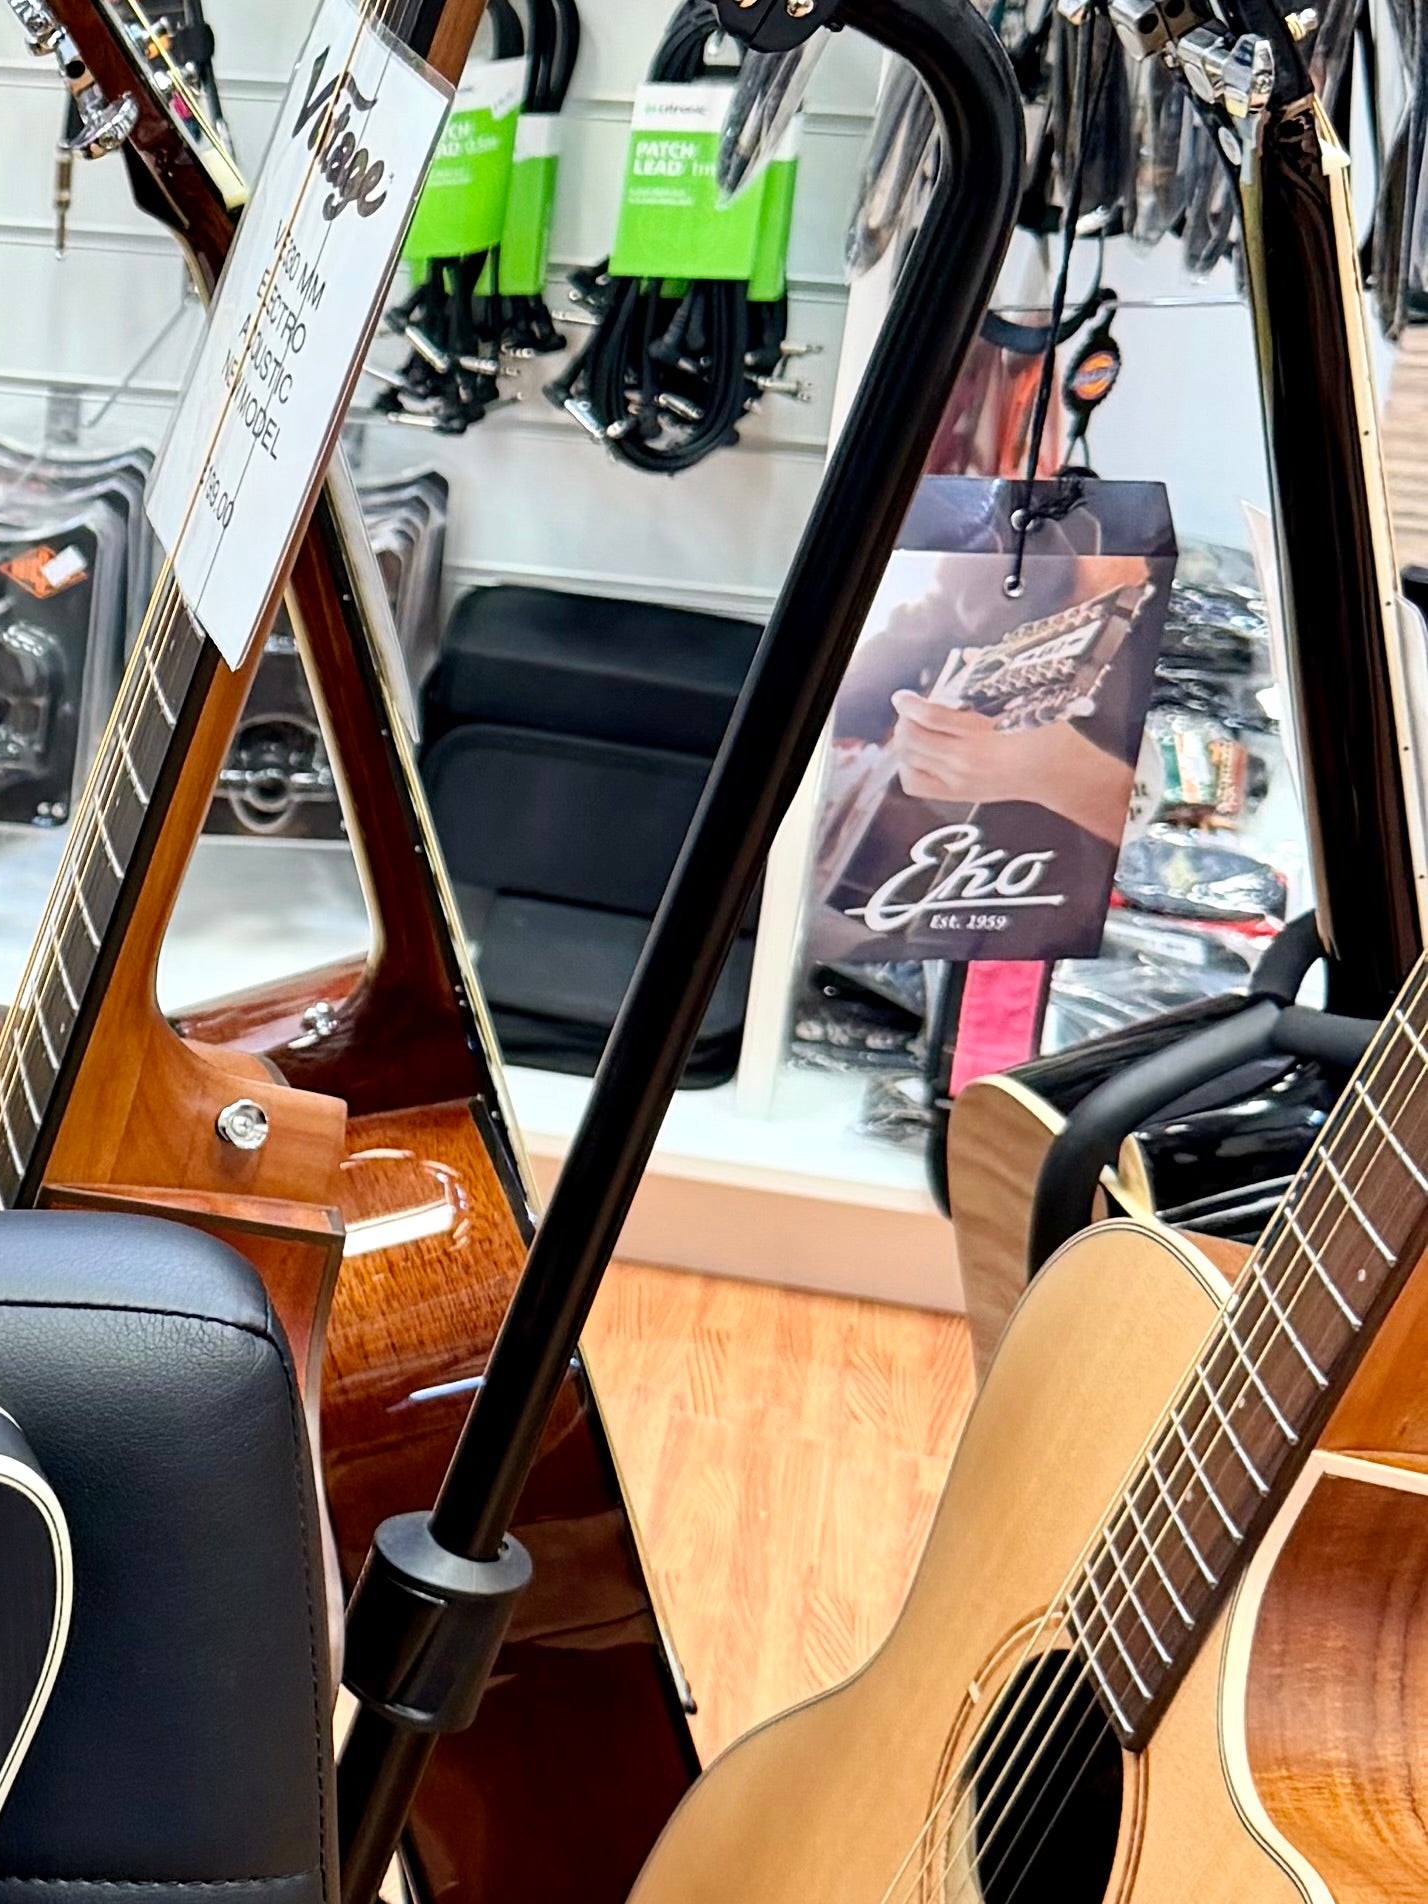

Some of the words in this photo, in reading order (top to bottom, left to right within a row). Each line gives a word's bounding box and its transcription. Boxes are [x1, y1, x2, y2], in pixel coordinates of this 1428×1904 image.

[633, 159, 681, 177] LEAD
[635, 140, 696, 159] PATCH
[297, 262, 328, 311] MM
[257, 268, 308, 355] EECTRO
[239, 312, 294, 405] AOUSTIC
[863, 823, 1055, 932] Eko
[929, 914, 961, 932] Est.
[966, 912, 1008, 931] 1959
